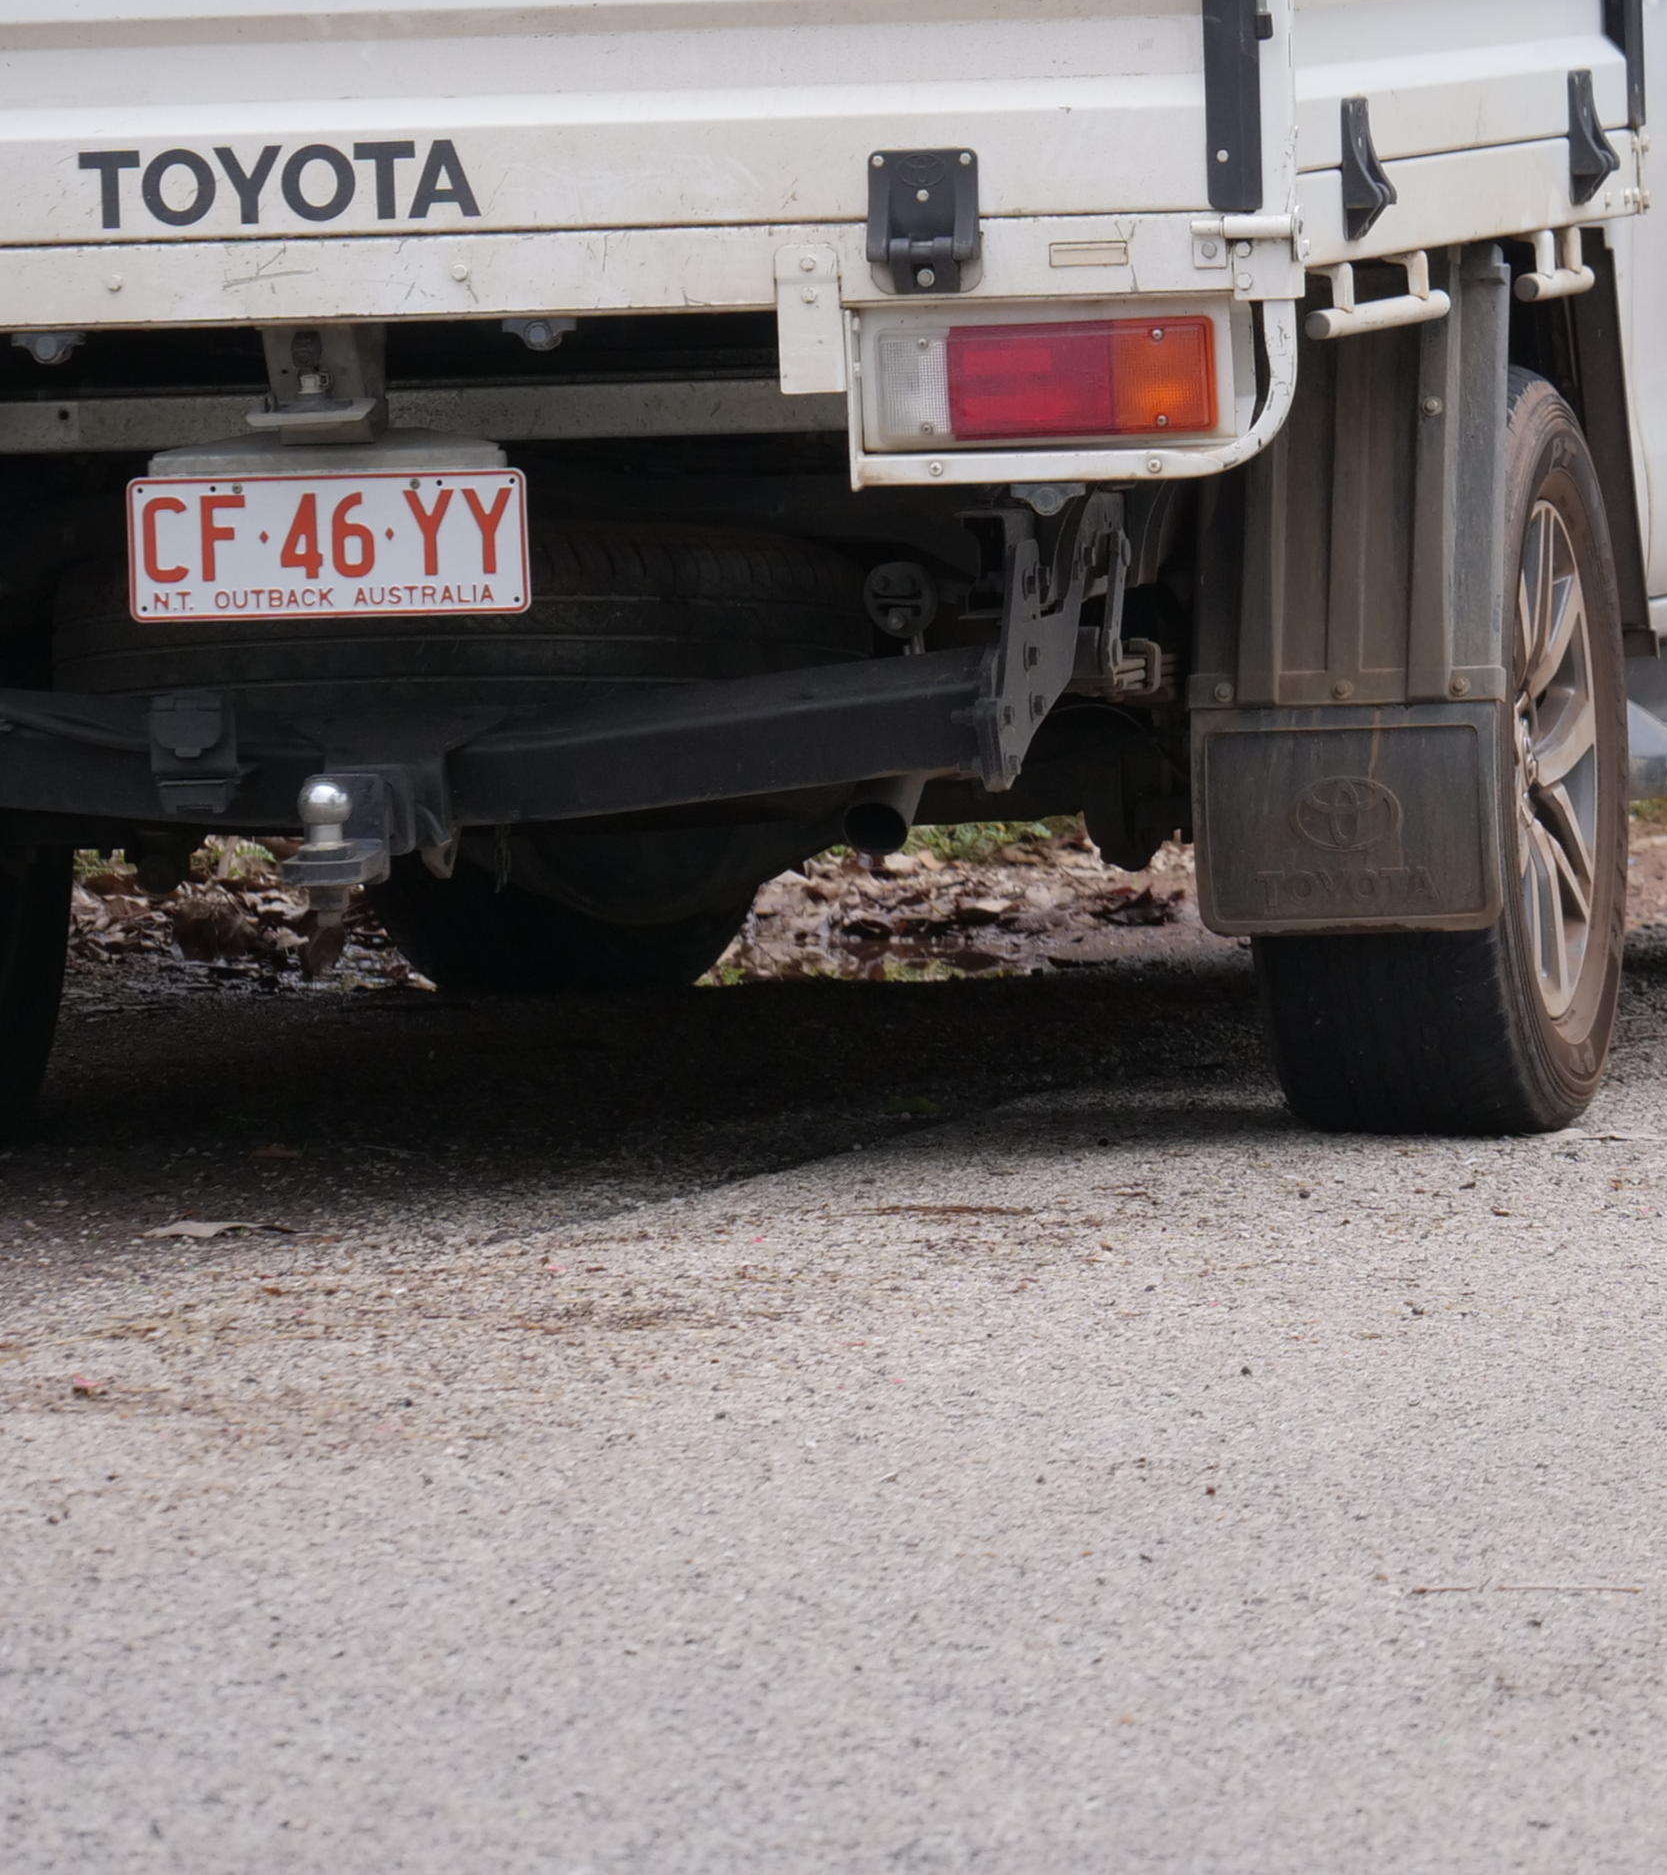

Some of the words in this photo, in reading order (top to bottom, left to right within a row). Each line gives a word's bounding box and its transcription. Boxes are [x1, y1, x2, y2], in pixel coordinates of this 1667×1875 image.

[78, 139, 482, 230] TOYOTA
[152, 589, 196, 613] N.T.
[213, 586, 335, 609] OUTBACK
[353, 582, 496, 606] AUSTRALIA
